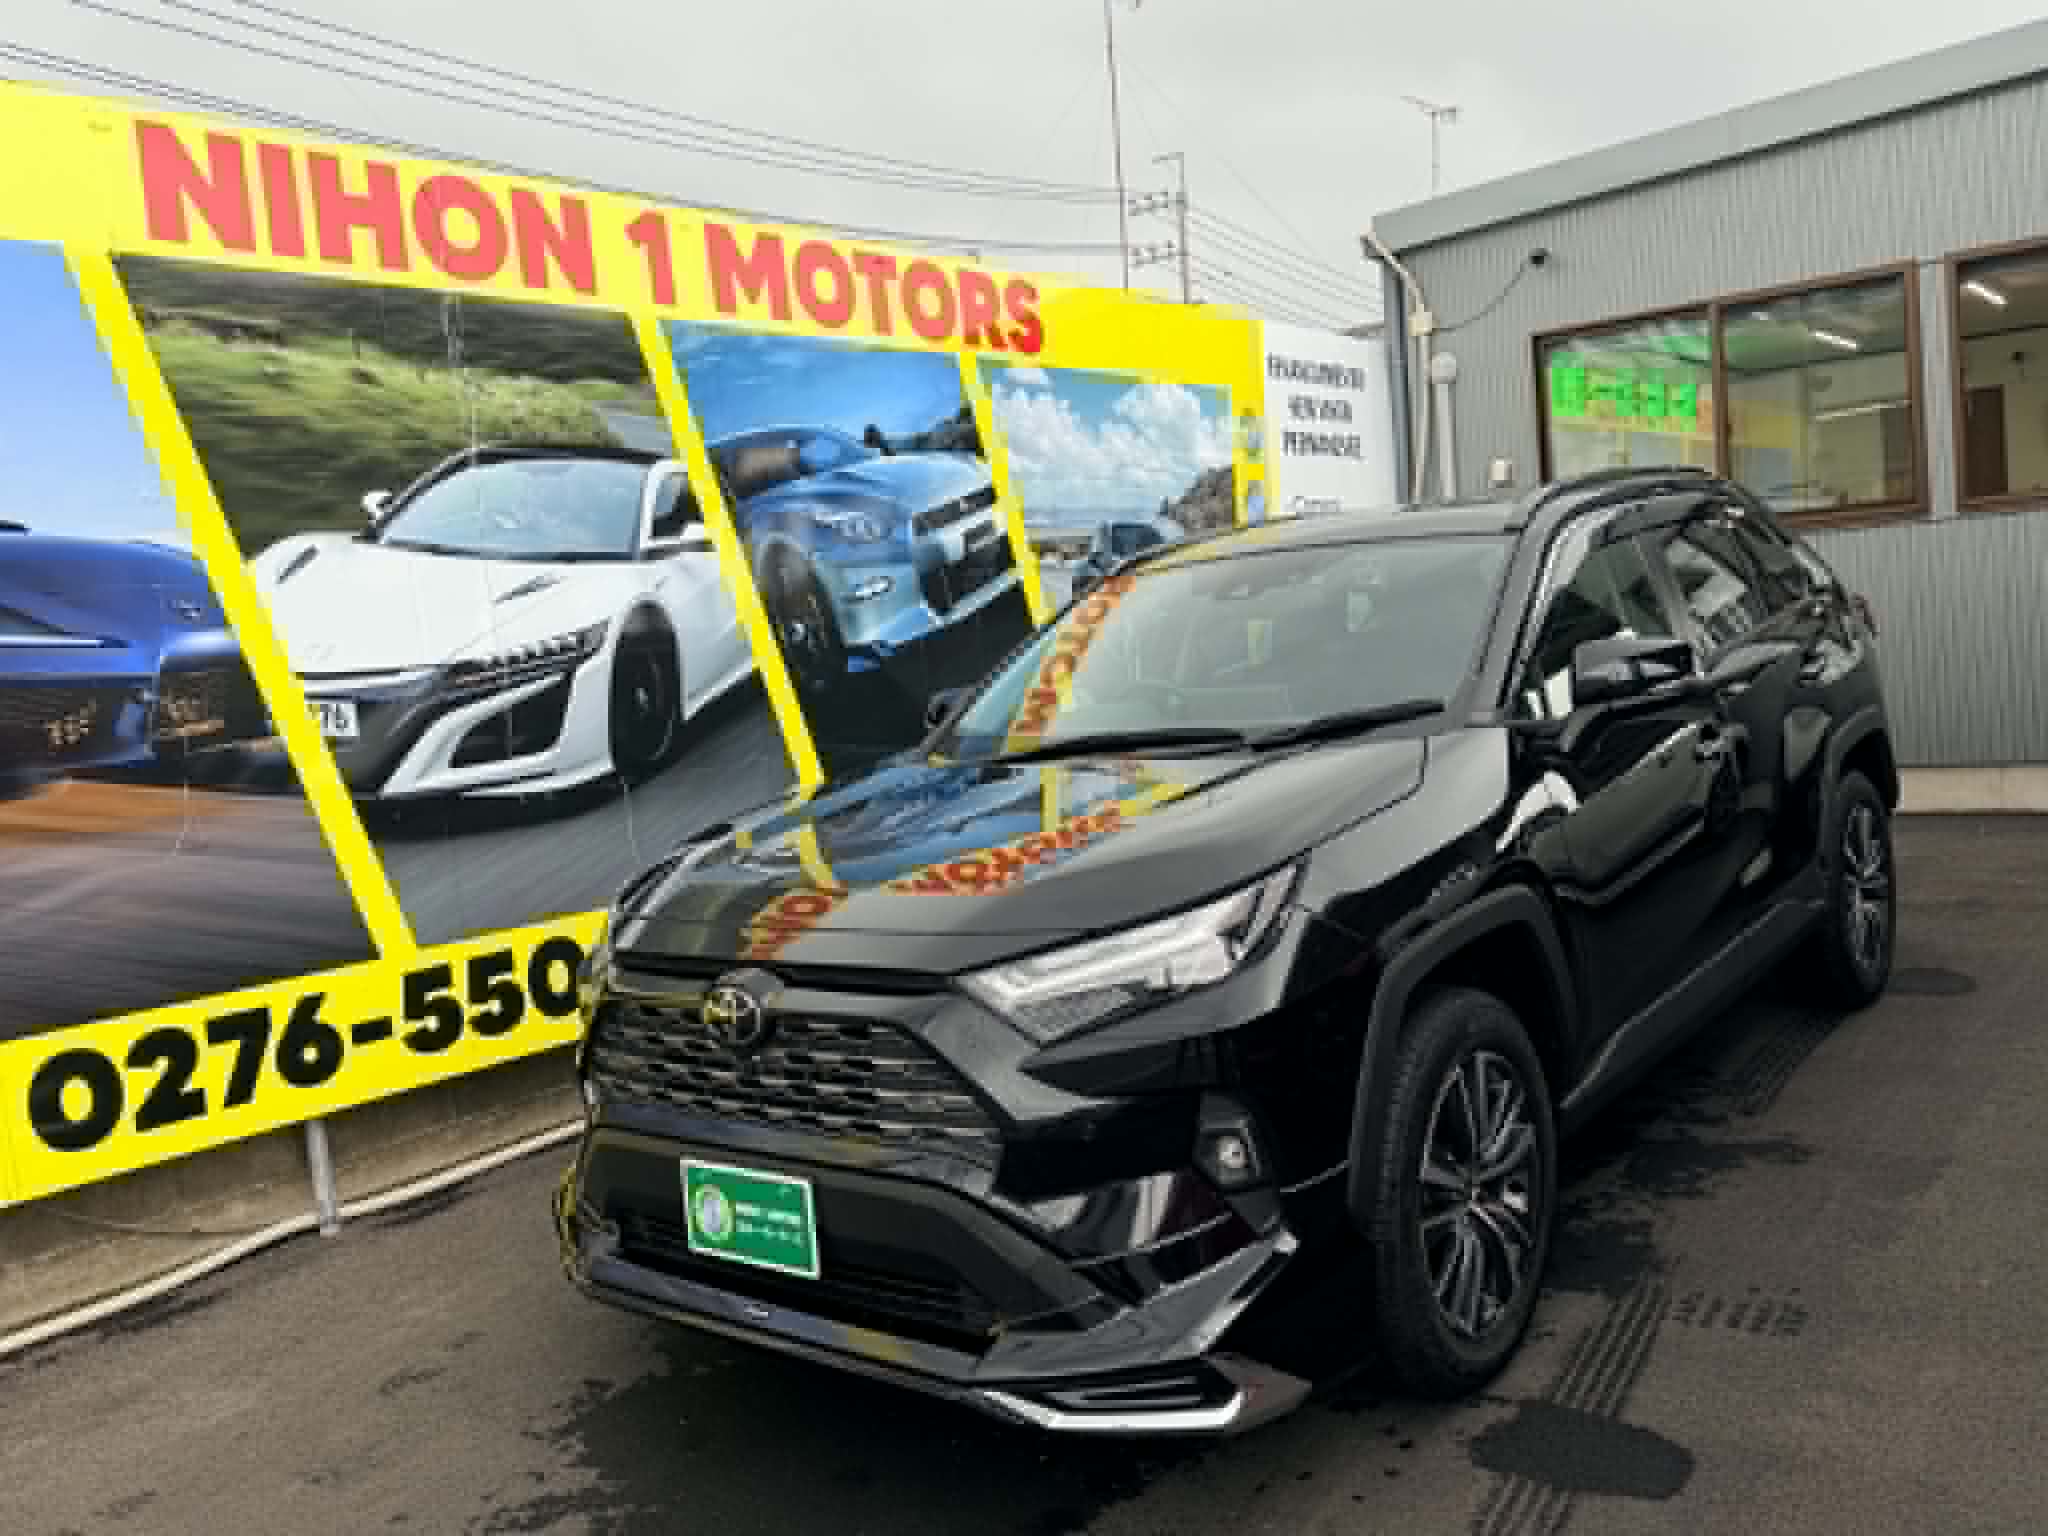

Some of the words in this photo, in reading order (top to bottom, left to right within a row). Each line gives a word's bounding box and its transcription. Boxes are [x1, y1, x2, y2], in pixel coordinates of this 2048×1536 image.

[135, 119, 597, 296] NIHON
[624, 209, 676, 304] 1
[704, 222, 1044, 353] MOTORS
